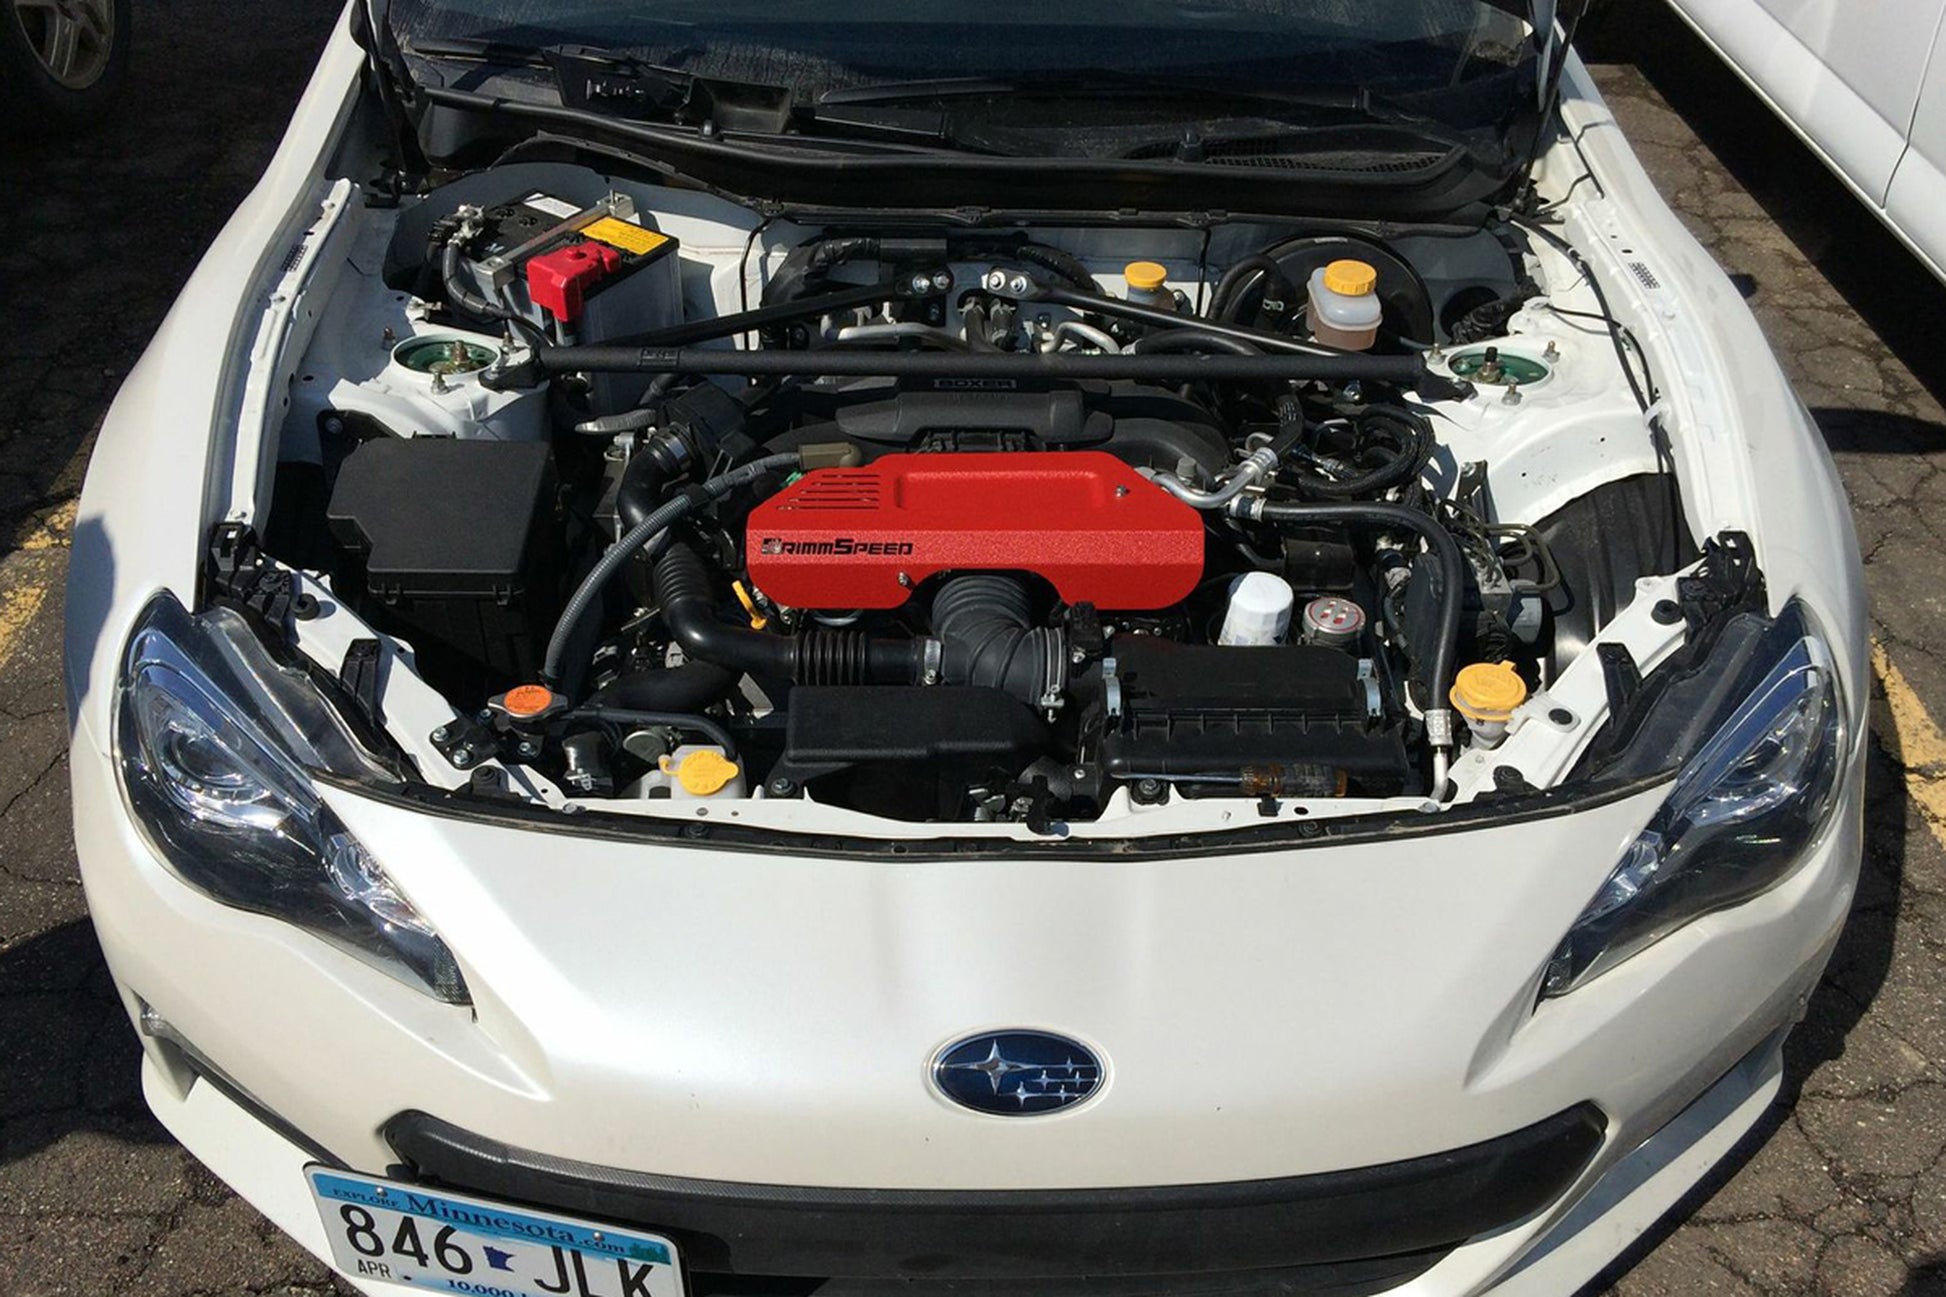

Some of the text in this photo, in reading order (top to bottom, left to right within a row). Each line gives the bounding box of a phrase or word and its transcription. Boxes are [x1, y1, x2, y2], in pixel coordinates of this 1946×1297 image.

[938, 379, 1013, 389] BOXER
[340, 1204, 654, 1297] 846 JLK
[357, 1259, 392, 1279] APR
